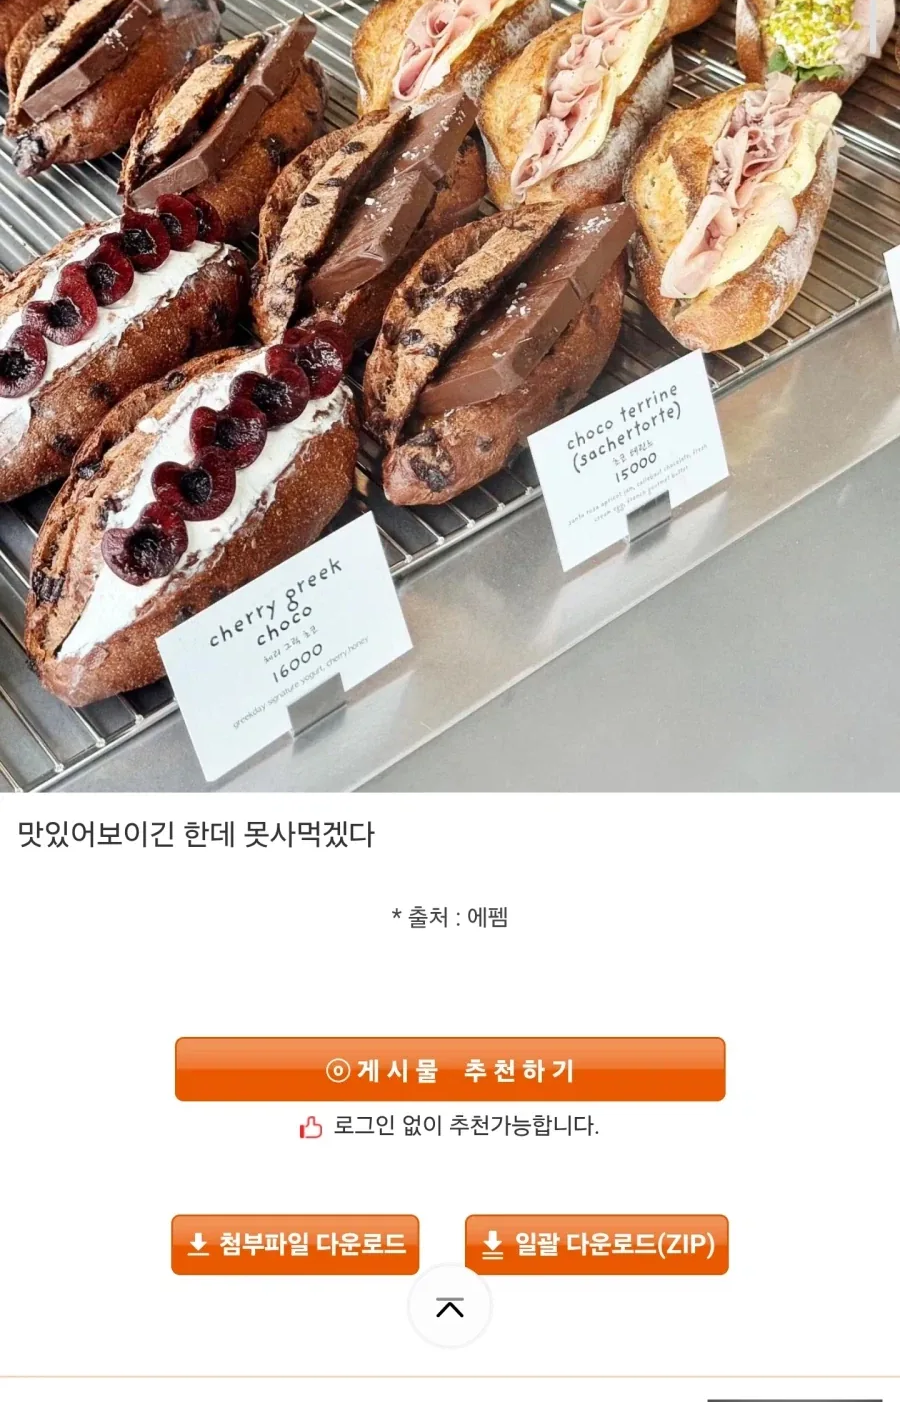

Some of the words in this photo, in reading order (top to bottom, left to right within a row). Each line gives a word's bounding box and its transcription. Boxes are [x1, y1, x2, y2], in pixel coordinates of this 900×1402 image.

[567, 419, 613, 449] choco
[620, 385, 677, 422] terrine
[573, 401, 681, 474] (sachertorte)
[616, 452, 657, 483] 15000
[210, 600, 276, 647] cherry
[285, 558, 342, 612] greek
[257, 606, 312, 646] choco
[273, 643, 323, 683] 16000
